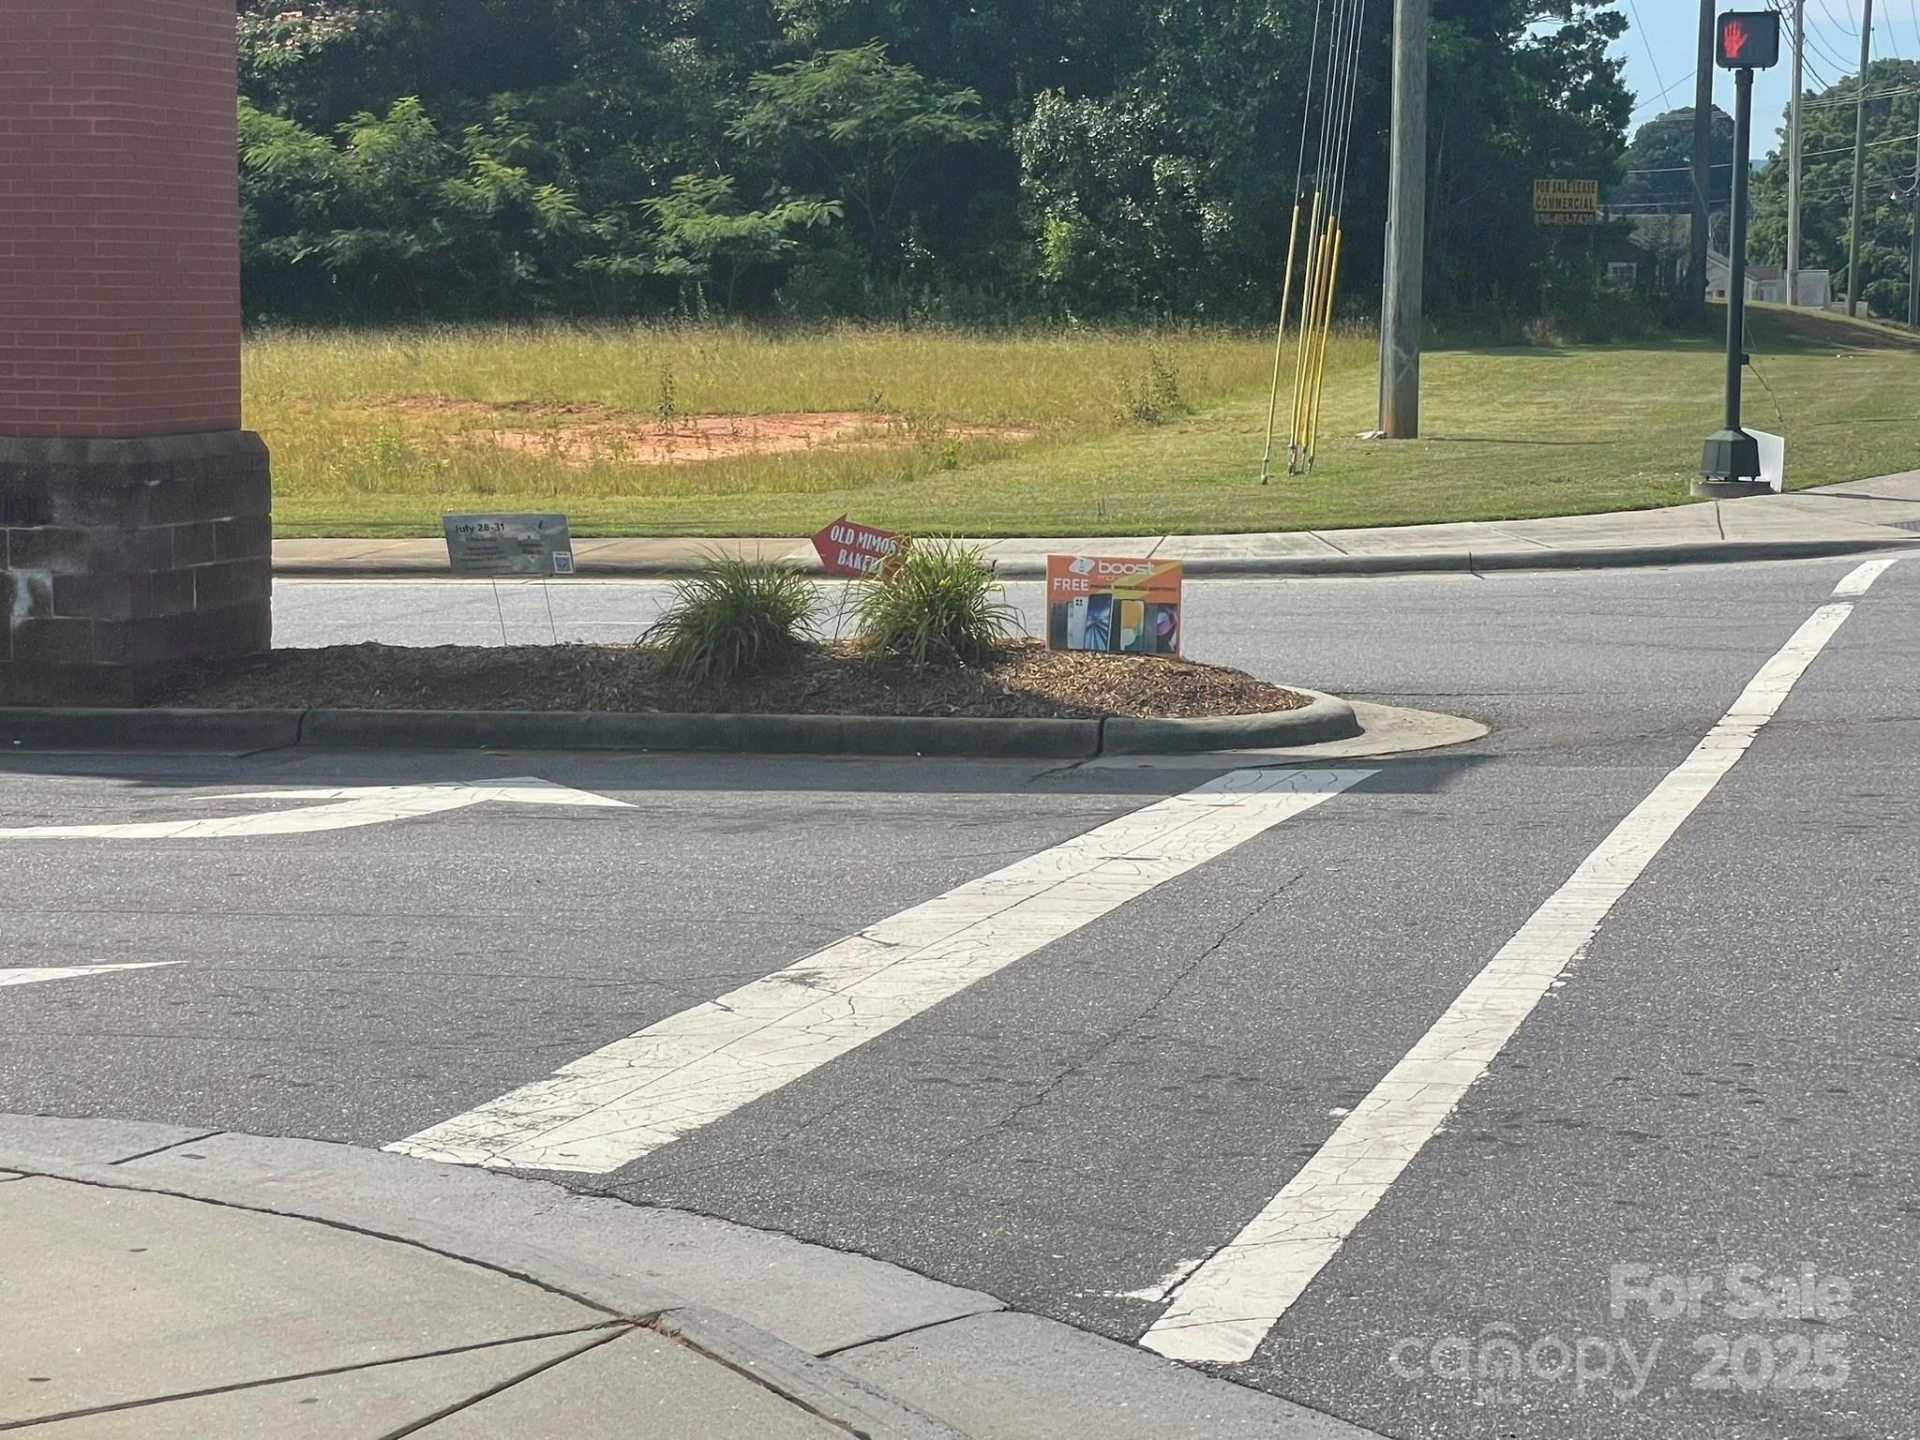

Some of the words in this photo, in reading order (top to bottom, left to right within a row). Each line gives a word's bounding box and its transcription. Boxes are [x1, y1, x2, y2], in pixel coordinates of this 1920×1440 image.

[1536, 181, 1550, 193] FOR
[1552, 181, 1570, 194] SALE
[1573, 181, 1596, 194] LEASE
[1535, 195, 1594, 210] COMMERCIAL
[454, 524, 475, 534] July
[478, 523, 505, 532] 28-31
[830, 525, 855, 545] OLD
[1098, 560, 1155, 575] boost
[1053, 578, 1089, 592] FREE
